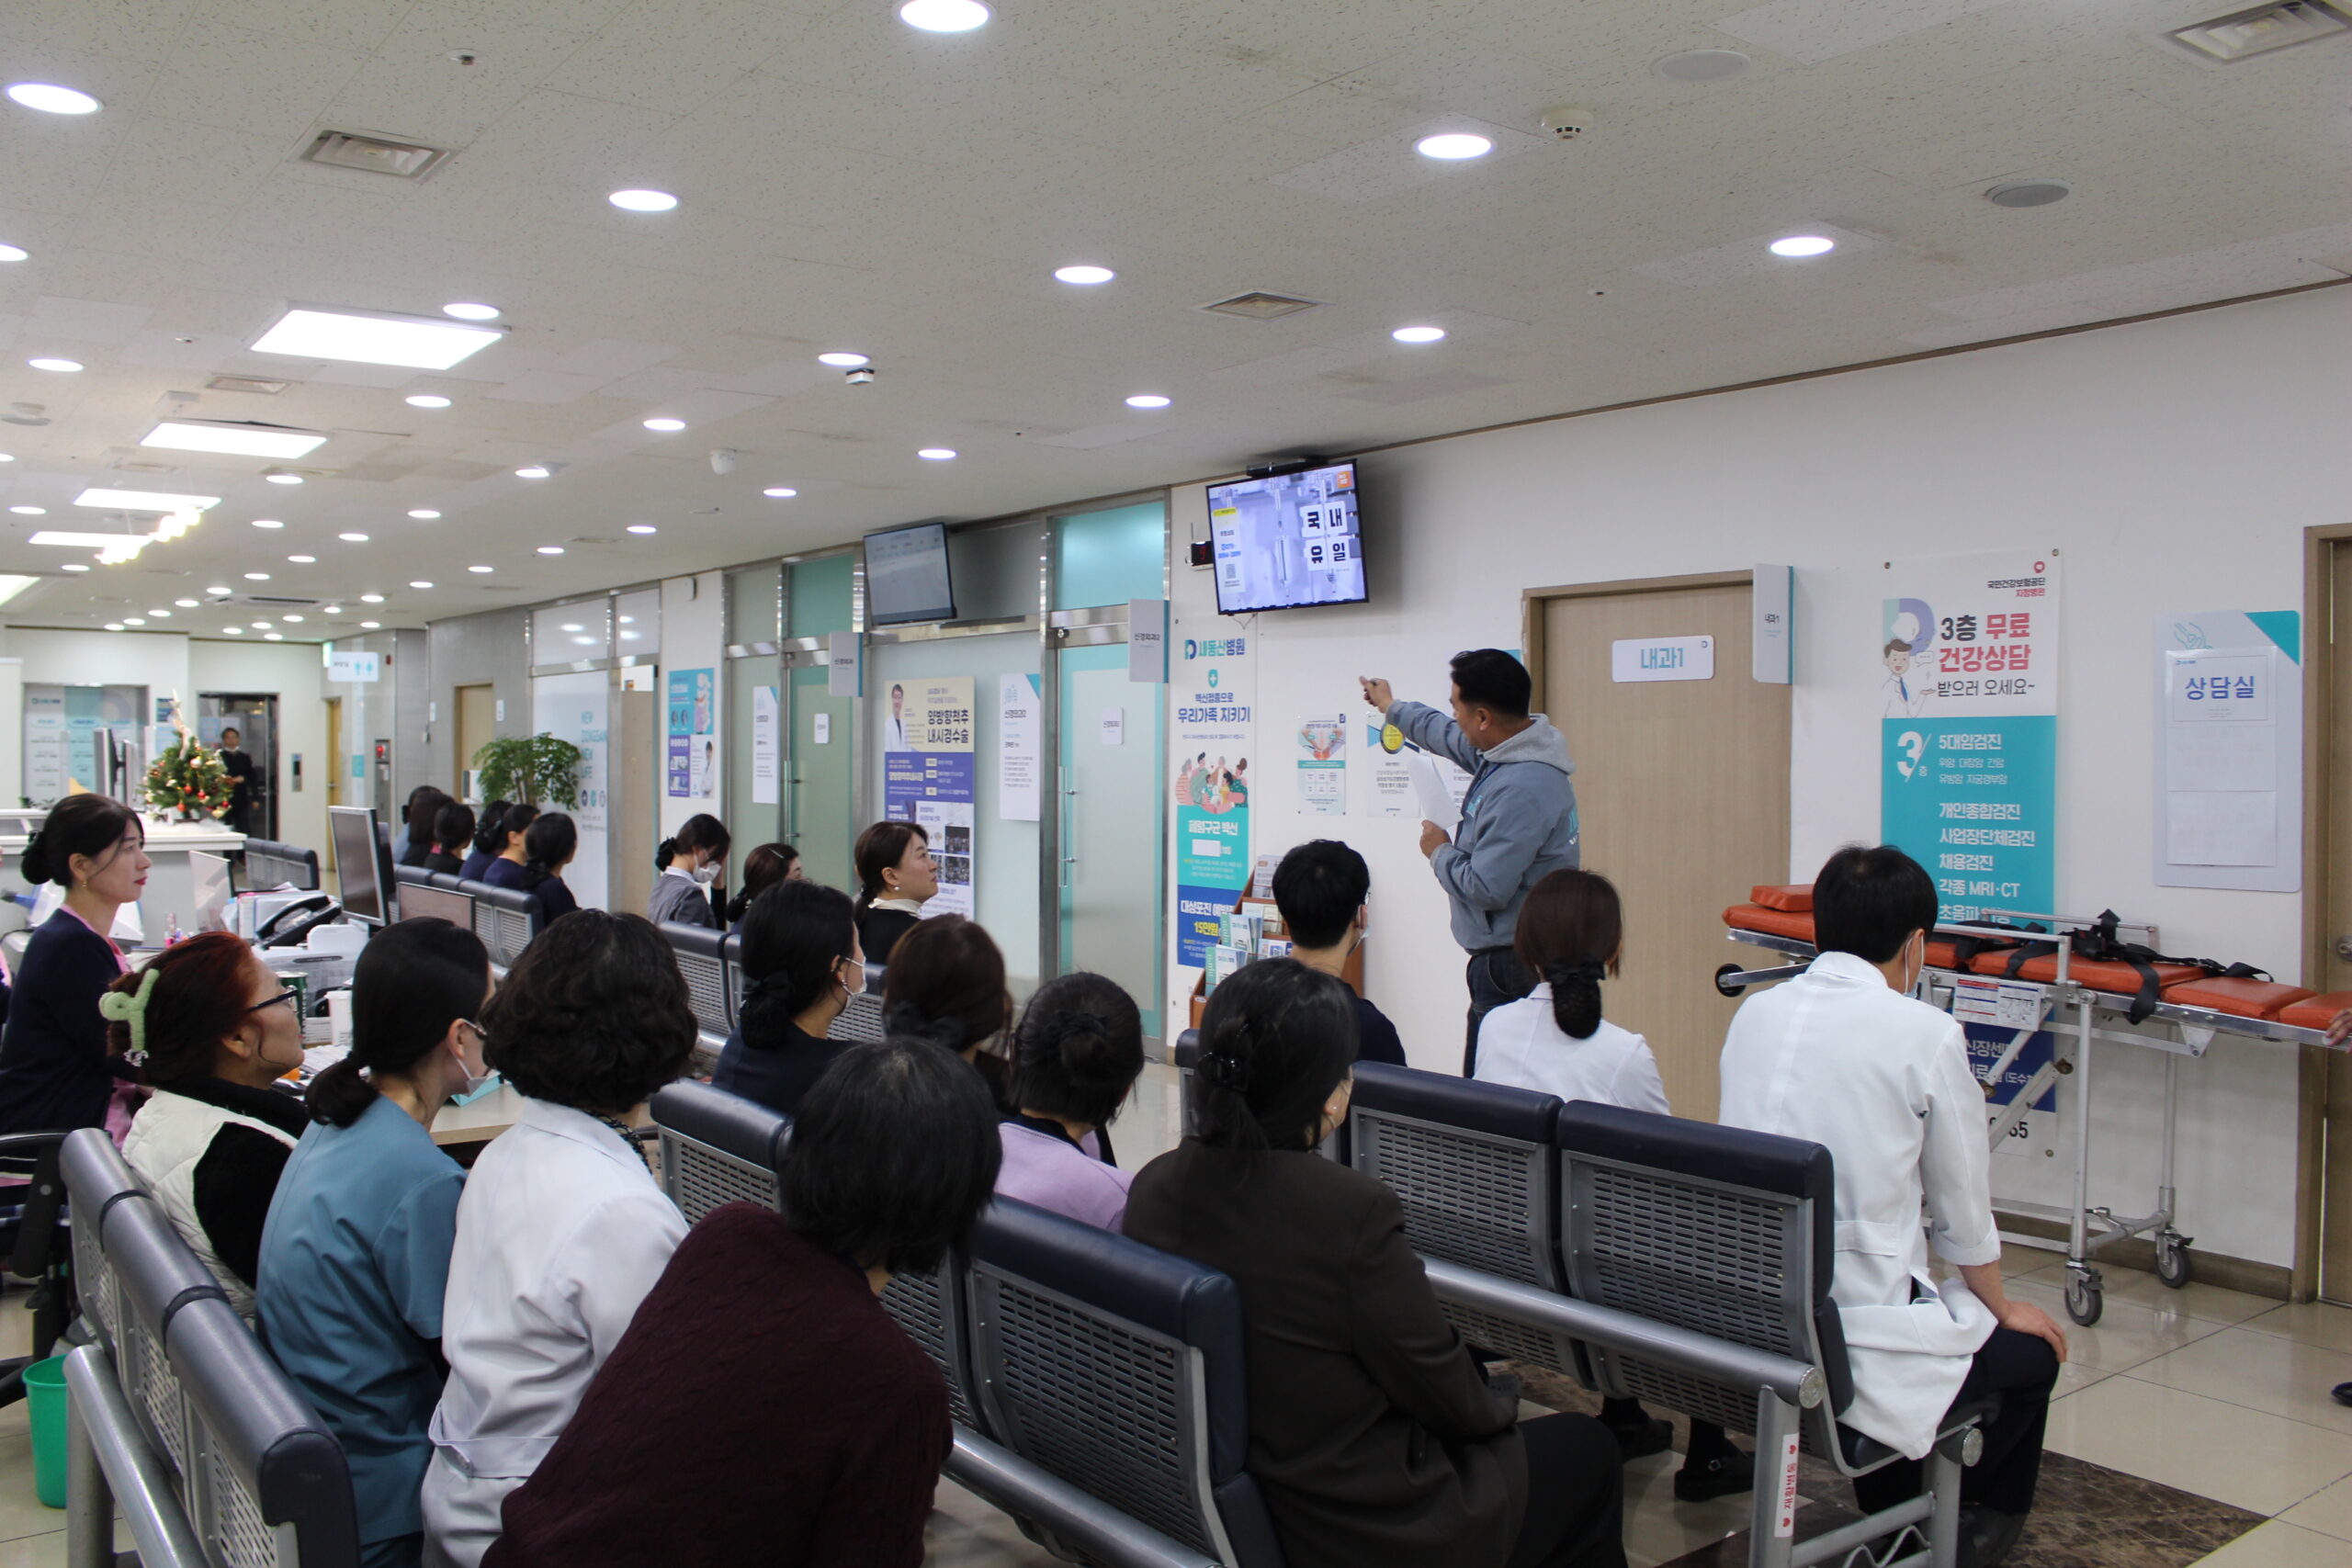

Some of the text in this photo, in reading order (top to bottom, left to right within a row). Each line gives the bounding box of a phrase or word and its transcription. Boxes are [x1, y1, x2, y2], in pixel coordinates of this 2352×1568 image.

[1307, 508, 1343, 530] 국내
[1311, 543, 1347, 564] 유일
[1987, 577, 2046, 589] 국민건강보험공단
[1940, 613, 2030, 641] 3층 무료
[1198, 637, 1245, 657] 새동산병원
[1641, 647, 1684, 670] 내과1
[1939, 645, 2031, 672] 건강상담
[1938, 678, 2035, 697] 받으러 오세요~
[2185, 675, 2255, 701] 상담실
[928, 709, 968, 725] 양방향척추
[1178, 706, 1250, 723] 우리가족 지키기
[928, 728, 968, 743] 내시경수술
[1939, 734, 2002, 750] 5대암검진
[1939, 758, 2005, 769] 위암 대장암 간암
[1939, 773, 1963, 784] 유방암
[1939, 803, 2020, 820] 개인종합검진
[1222, 821, 1238, 836] 백신
[1939, 828, 2035, 847] 사업장단체검진
[1939, 853, 1994, 871] 채용검진
[1939, 878, 1966, 896] 각종
